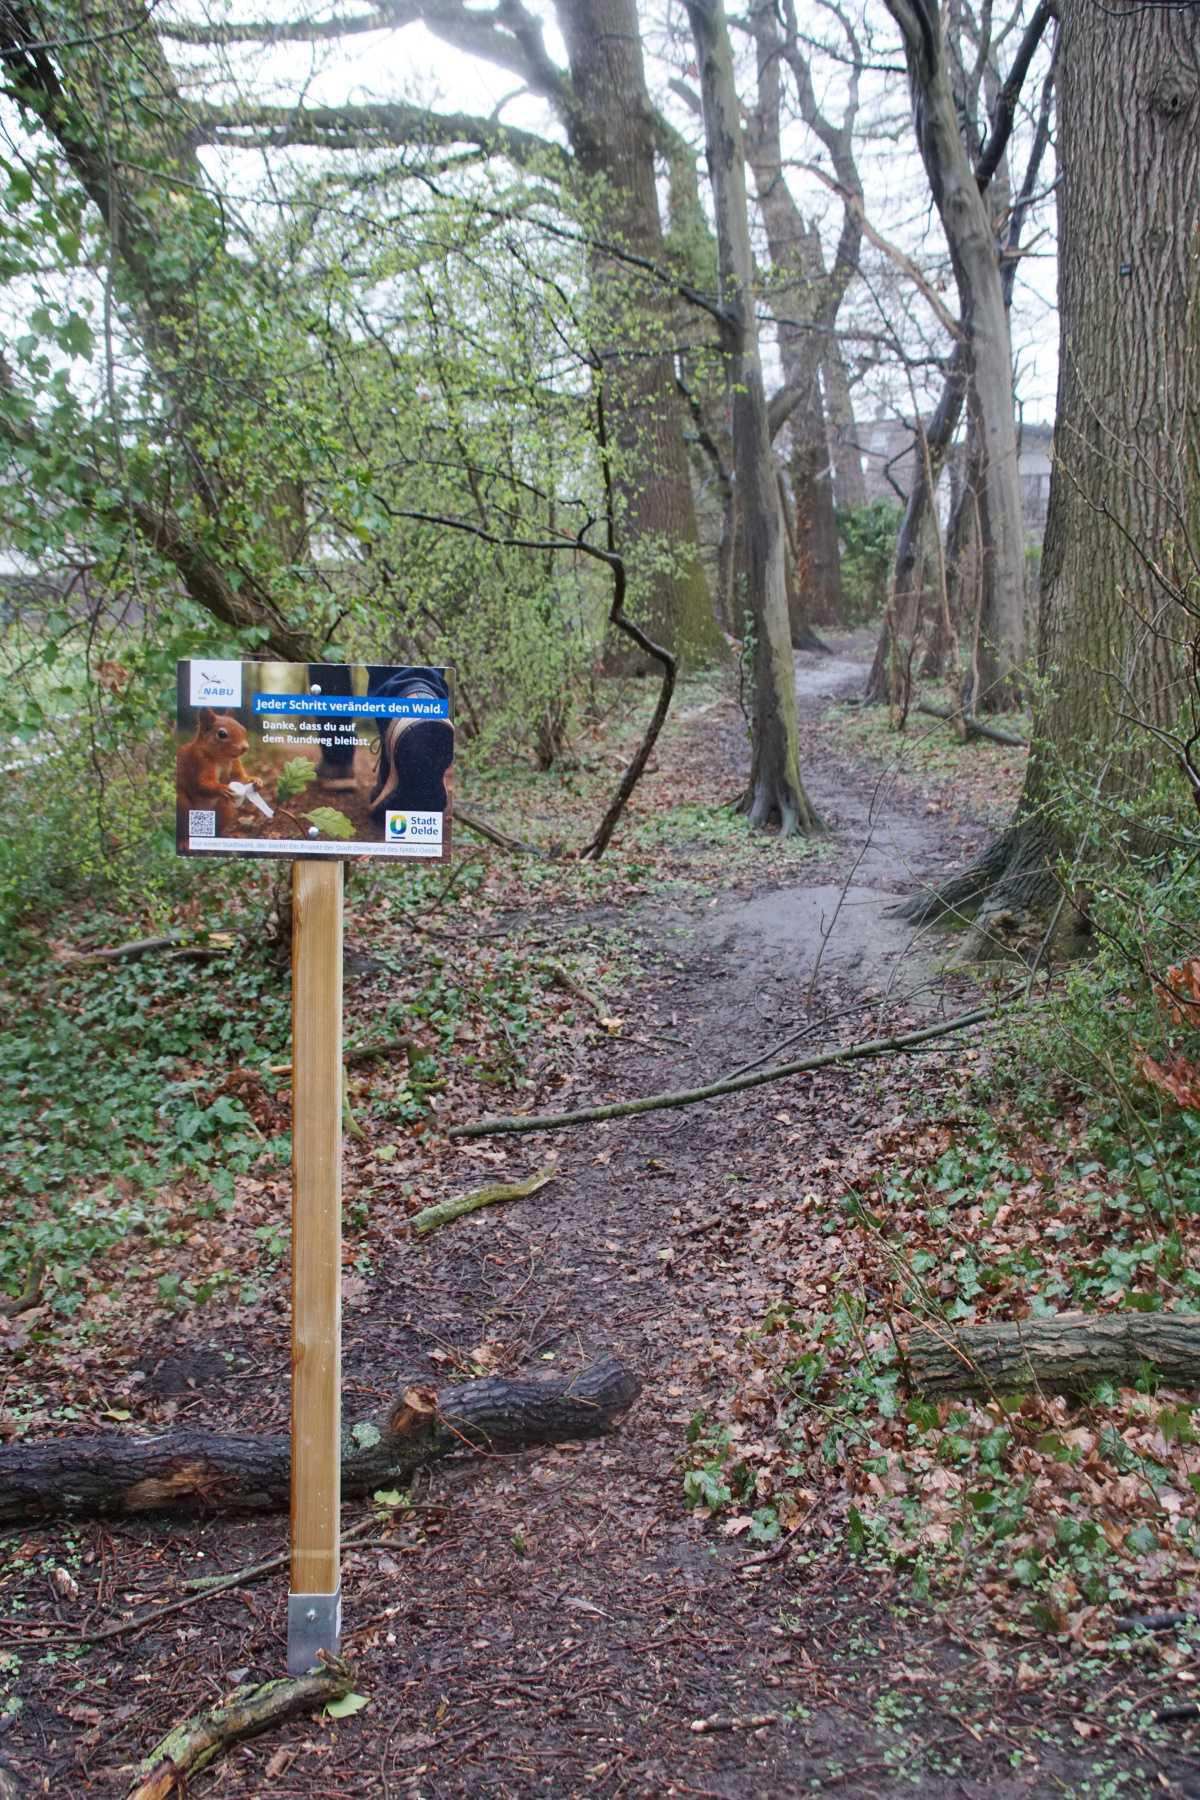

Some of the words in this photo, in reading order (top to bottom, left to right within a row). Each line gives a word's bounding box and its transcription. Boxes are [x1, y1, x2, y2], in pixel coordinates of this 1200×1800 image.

[203, 687, 234, 696] NABU
[256, 698, 286, 711] Jeder
[289, 700, 327, 711] Schritt
[330, 701, 386, 712] verändert
[388, 702, 410, 713] den
[412, 703, 444, 715] Wald.
[262, 720, 297, 731] Danke,
[299, 721, 321, 731] dass
[324, 722, 337, 731] du
[339, 722, 356, 732] auf
[262, 734, 285, 744] dem
[286, 735, 332, 747] Rundweg
[335, 736, 371, 746] bleibst.
[411, 817, 437, 825] Stadt
[411, 826, 439, 835] Oelde
